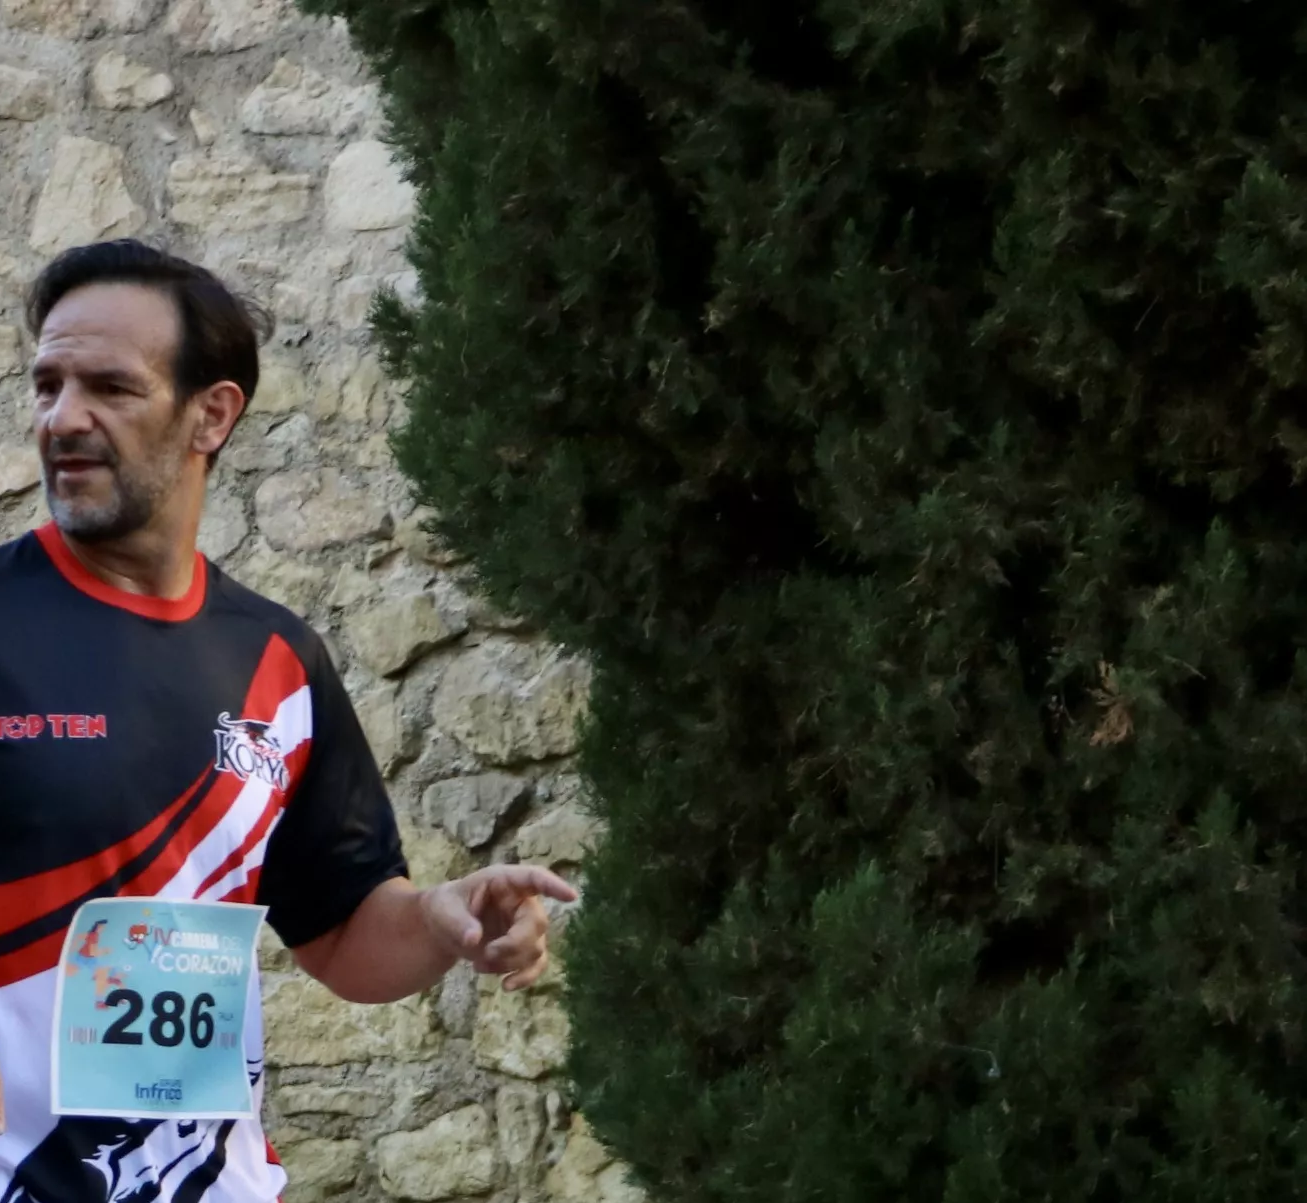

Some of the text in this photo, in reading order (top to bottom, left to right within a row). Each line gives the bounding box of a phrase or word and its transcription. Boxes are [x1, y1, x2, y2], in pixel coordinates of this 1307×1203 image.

[46, 714, 107, 738] TEN
[154, 928, 173, 946] IV
[101, 988, 215, 1049] 286
